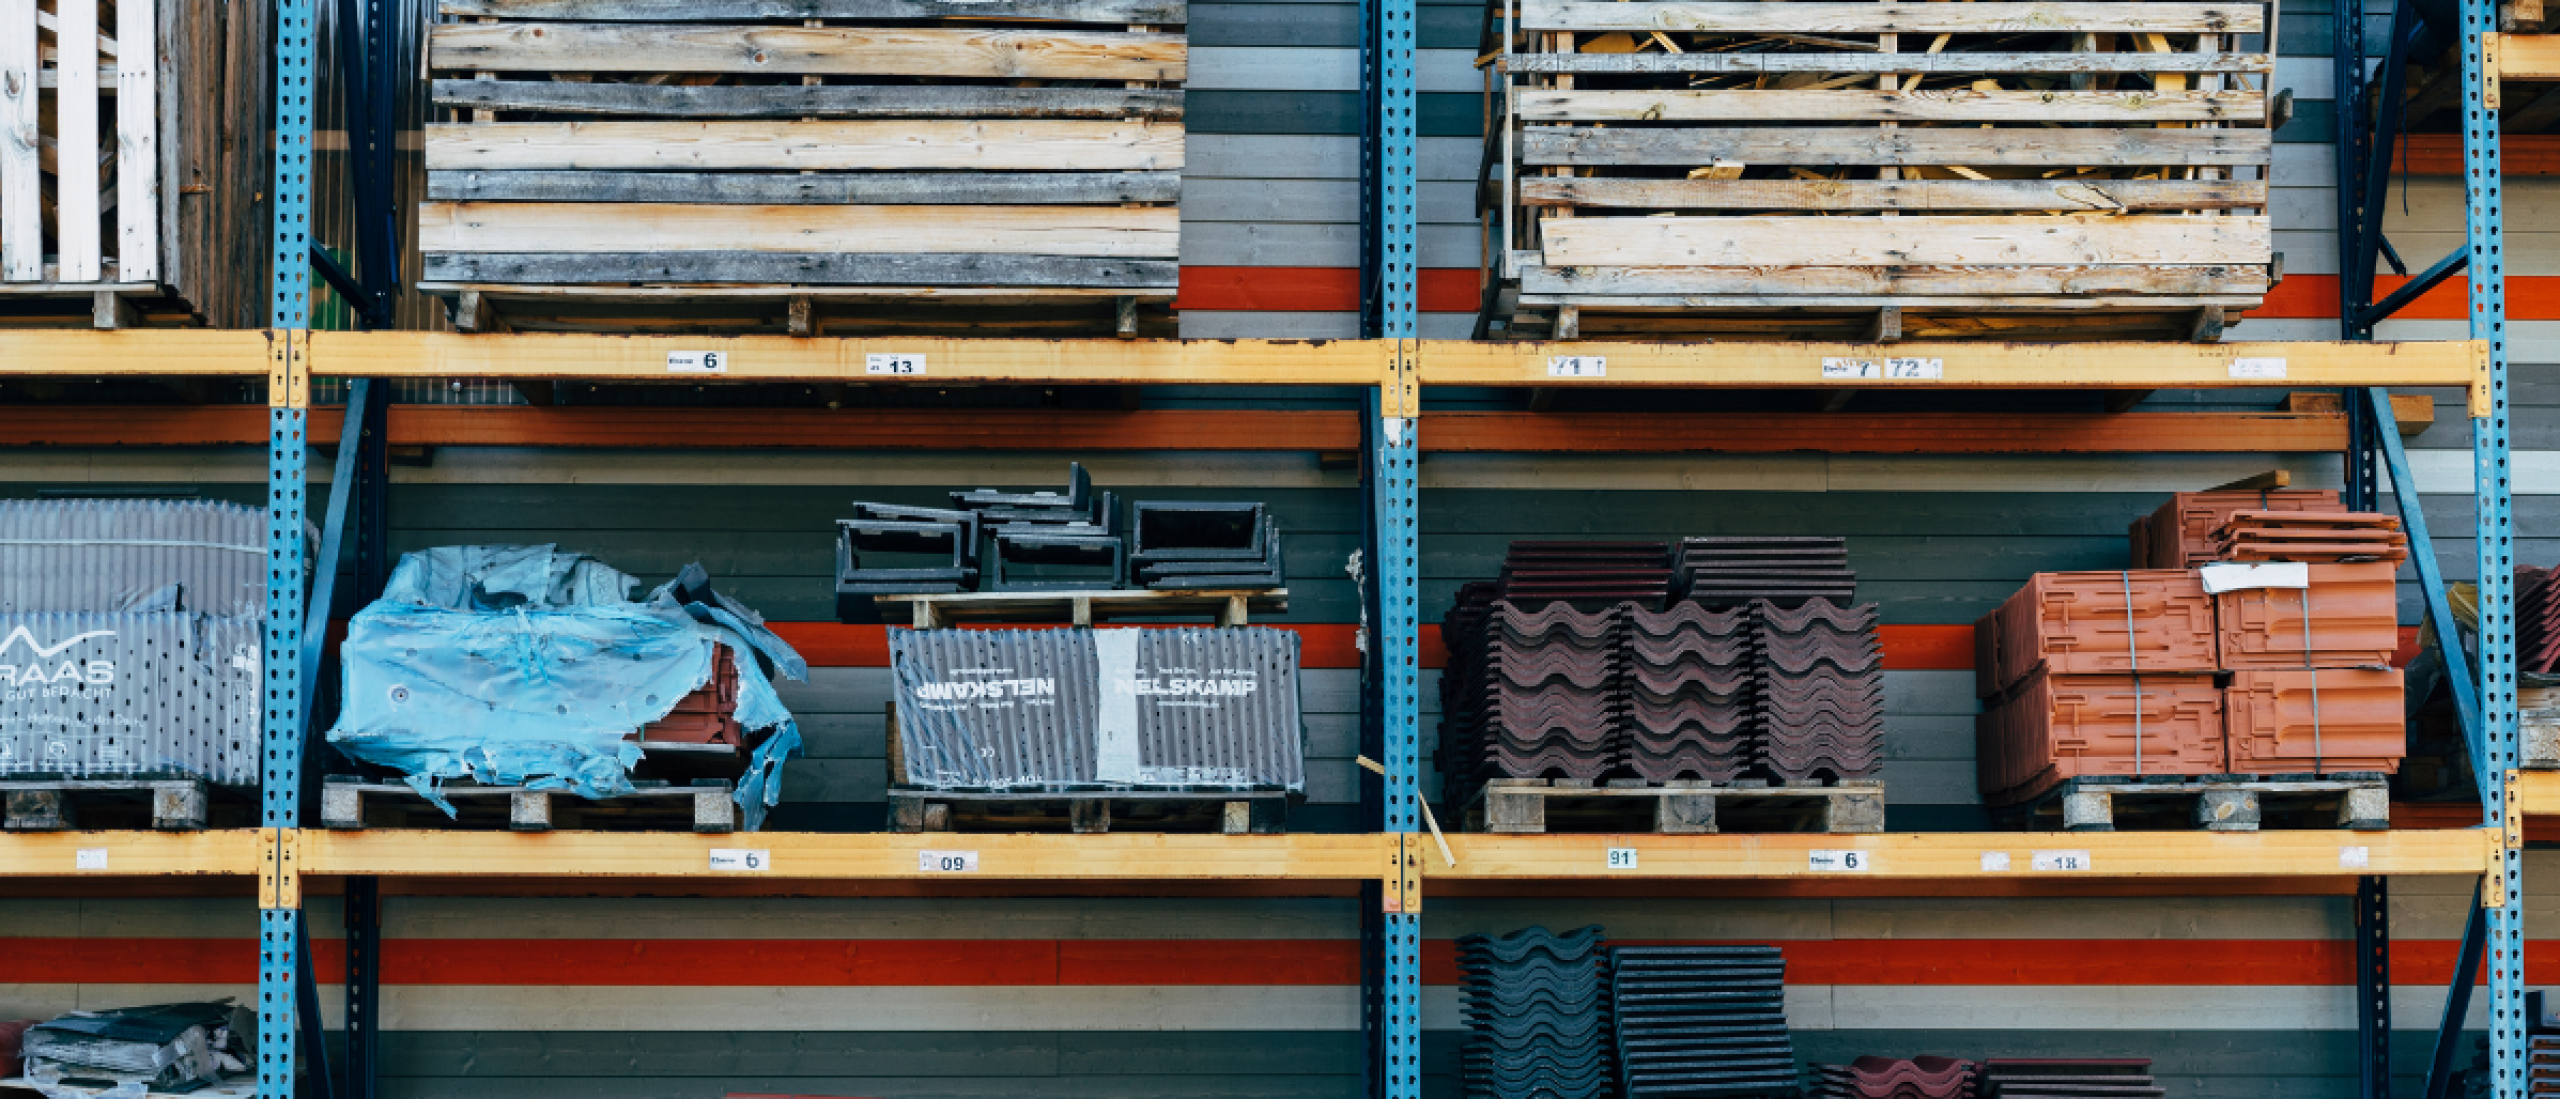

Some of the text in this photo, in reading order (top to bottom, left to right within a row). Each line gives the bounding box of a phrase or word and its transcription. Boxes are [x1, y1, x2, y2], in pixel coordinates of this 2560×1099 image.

[703, 352, 717, 369] 6
[890, 360, 914, 374] 13
[1890, 359, 1919, 377] 72
[6, 686, 111, 702] GUT BEDACHT
[917, 678, 1055, 699] NELSKAMP
[1113, 678, 1258, 696] NELSKAMP
[745, 852, 759, 868] 6
[941, 857, 965, 870] 09
[1610, 850, 1628, 865] 91
[1845, 852, 1859, 868] 6
